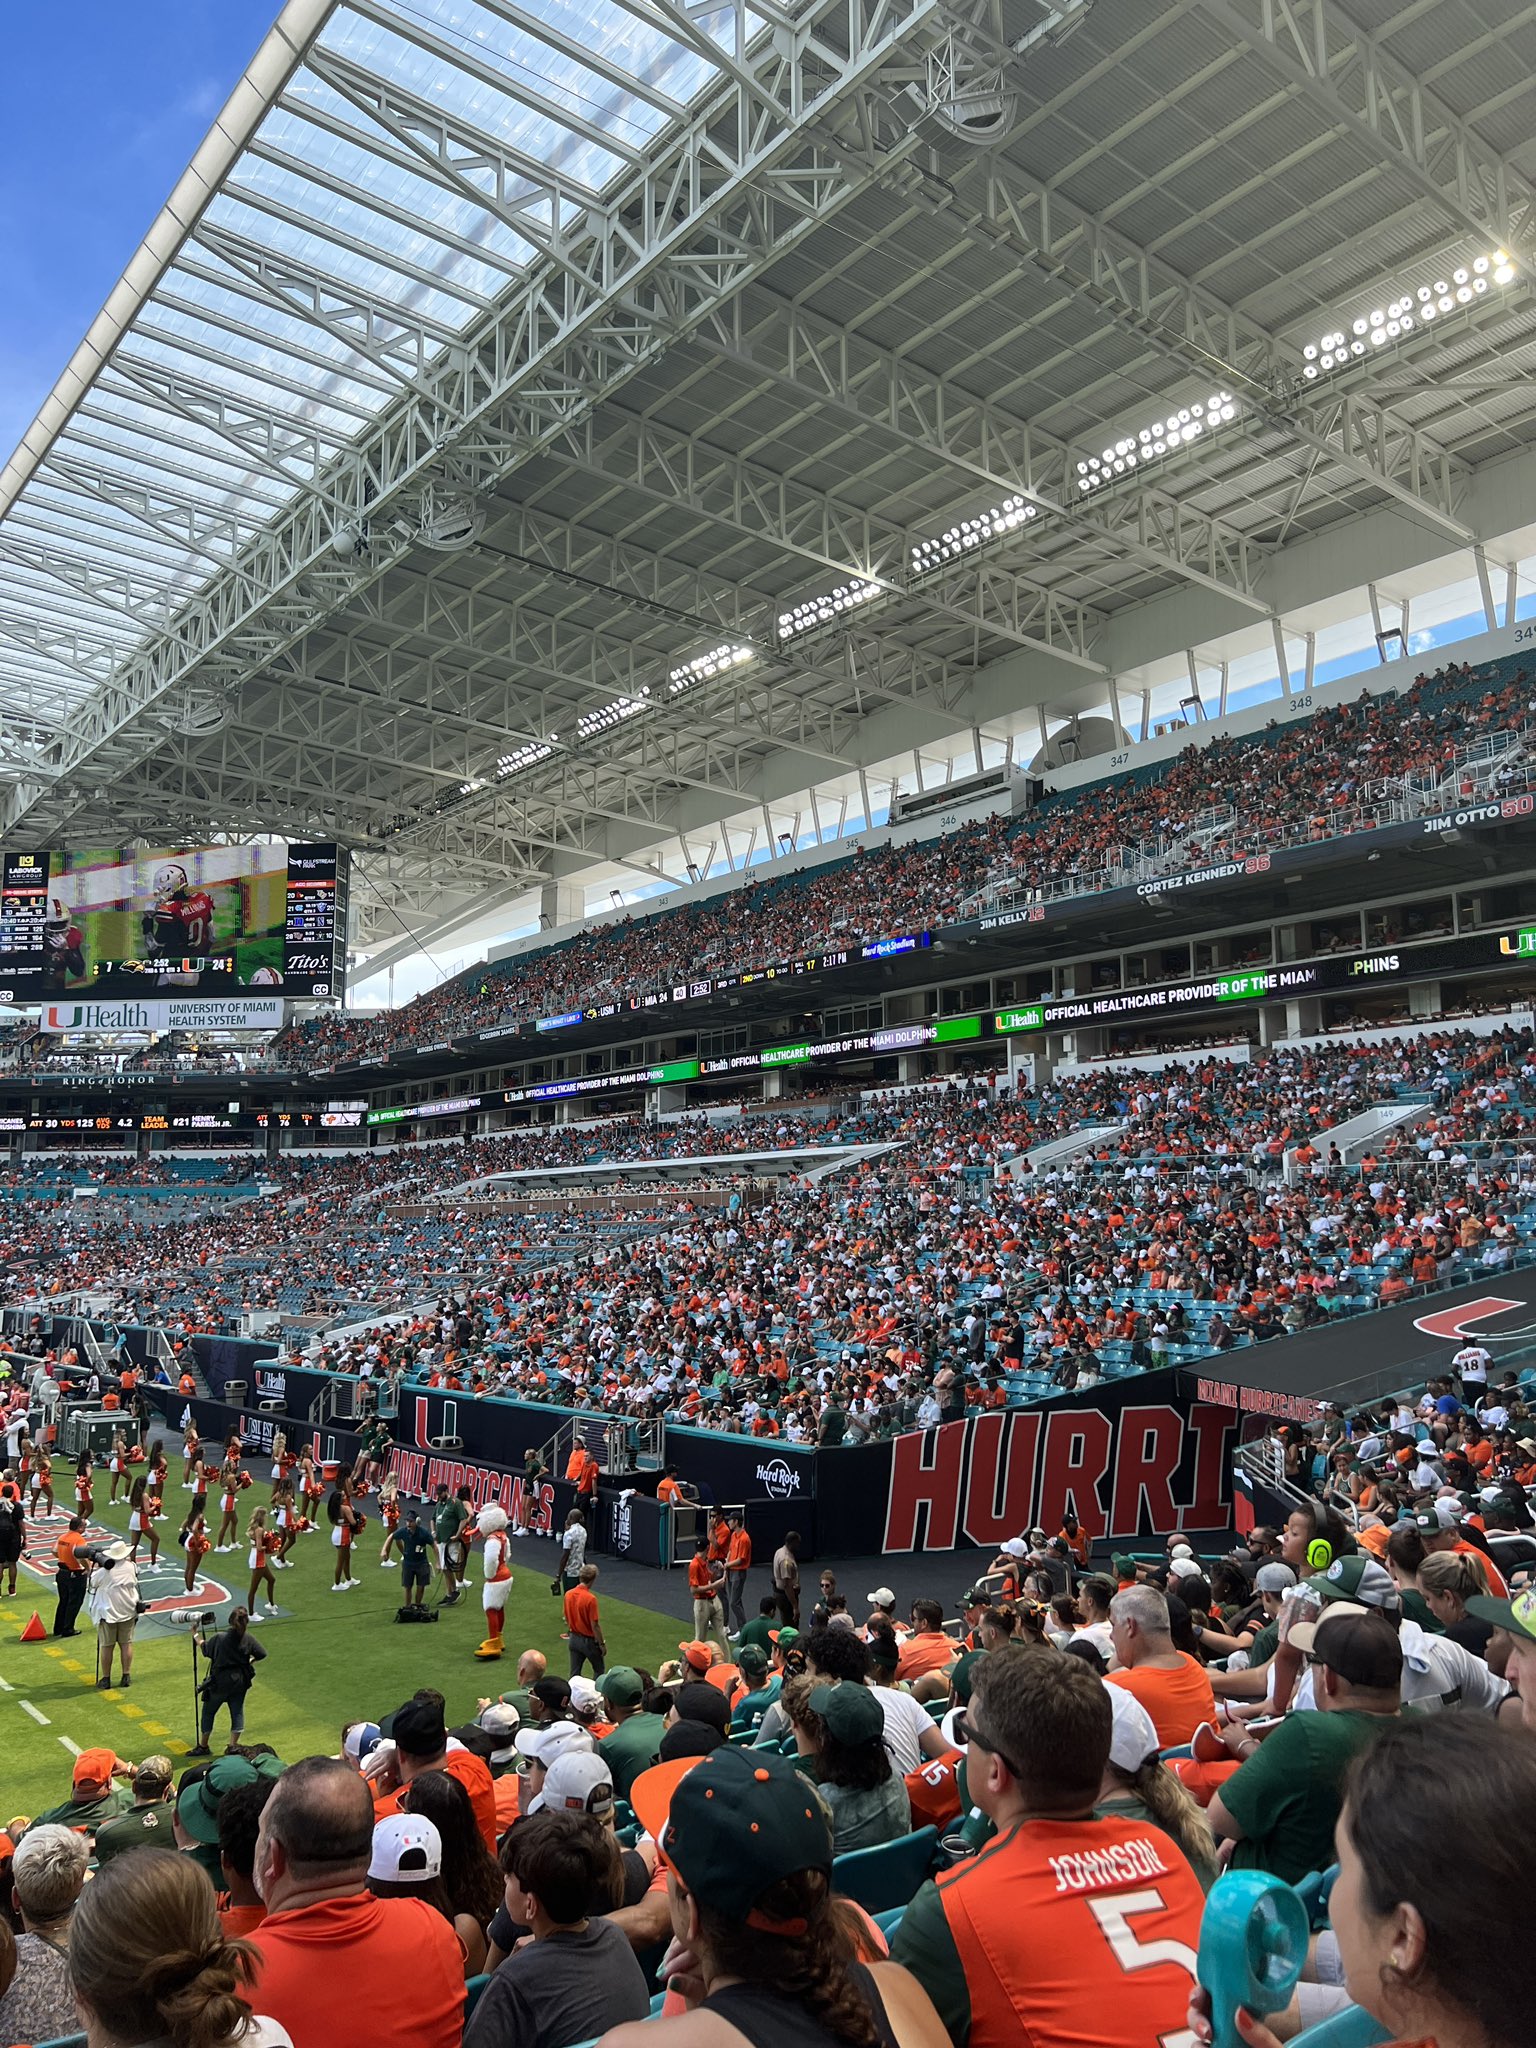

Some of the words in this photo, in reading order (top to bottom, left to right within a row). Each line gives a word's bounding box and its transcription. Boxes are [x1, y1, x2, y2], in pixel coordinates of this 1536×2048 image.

[1289, 695, 1313, 712] 348
[1110, 752, 1129, 767] 347
[940, 814, 956, 827] 346
[1424, 815, 1451, 833] JIM
[1455, 805, 1500, 825] OTTO
[1501, 794, 1534, 818] 50
[845, 838, 859, 849] 345
[744, 870, 756, 880] 344
[1137, 877, 1183, 896] CORTEZ
[1185, 862, 1245, 884] KENNEDY
[1245, 854, 1271, 874] 96
[980, 919, 998, 930] JIM
[998, 911, 1028, 927] KELLY
[1028, 907, 1045, 922] 12
[861, 945, 877, 957] Hard
[877, 942, 891, 954] Rock
[890, 938, 916, 951] Stadium
[153, 959, 170, 967] 2:52
[182, 957, 205, 973] U
[212, 959, 225, 970] 24
[806, 960, 816, 970] 17
[823, 954, 836, 968] 2:17
[837, 952, 847, 964] PM
[106, 962, 113, 973] 7
[742, 974, 753, 984] 2ND
[766, 968, 776, 979] 10
[0, 992, 12, 1000] CC
[314, 985, 327, 994] CC
[645, 996, 658, 1006] MIA
[659, 991, 668, 1002] 24
[675, 988, 684, 998] 40
[693, 983, 708, 995] 2:52
[169, 1003, 226, 1014] UNIVERSITY
[227, 1003, 241, 1013] OF
[242, 1002, 276, 1013] MIAMI
[996, 1010, 1040, 1030] UHealth
[1044, 1003, 1092, 1021] OFFICIAL
[1093, 991, 1166, 1014] HEALTHCARE
[1168, 983, 1229, 1004] PROVIDER
[1231, 979, 1248, 993] OF
[1252, 974, 1277, 990] THE
[48, 1003, 149, 1029] UHealth
[601, 1006, 614, 1017] USM
[617, 1003, 622, 1013] 7
[168, 1016, 206, 1026] HEALTH
[207, 1015, 246, 1025] SYSTEM
[1516, 1016, 1531, 1026] 249
[700, 1058, 729, 1074] UHealth
[731, 1055, 760, 1068] OFFICIAL
[761, 1049, 805, 1063] HEALTHCARE
[805, 1045, 842, 1057] PROVIDER
[842, 1041, 853, 1051] OF
[853, 1039, 869, 1050] THE
[870, 1035, 894, 1047] MIAMI
[896, 1027, 938, 1043] DOLPHINS
[63, 1078, 96, 1086] RING
[108, 1076, 155, 1085] HONOR
[525, 1087, 546, 1099] OFFICIAL
[546, 1083, 577, 1096] HEALTHCARE
[576, 1079, 602, 1091] PROVIDER
[601, 1078, 609, 1087] OF
[609, 1077, 620, 1086] THE
[620, 1074, 636, 1084] MIAMI
[636, 1070, 664, 1082] DOLPHINS
[1380, 1110, 1394, 1119] 149
[45, 1119, 58, 1128] 30
[76, 1119, 94, 1128] 125
[117, 1118, 133, 1127] 4.2
[173, 1118, 189, 1126] #21
[1458, 1350, 1481, 1360] WILLIAMS
[1463, 1359, 1479, 1372] 18
[255, 1370, 286, 1391] UHealth
[1197, 1378, 1239, 1409] MIAMI
[1240, 1386, 1324, 1423] HURRICANES
[414, 1395, 458, 1450] U
[756, 1464, 779, 1483] Hard
[778, 1468, 801, 1490] Rock
[918, 1759, 950, 1787] 15
[1048, 1837, 1169, 1892] JOHNSON
